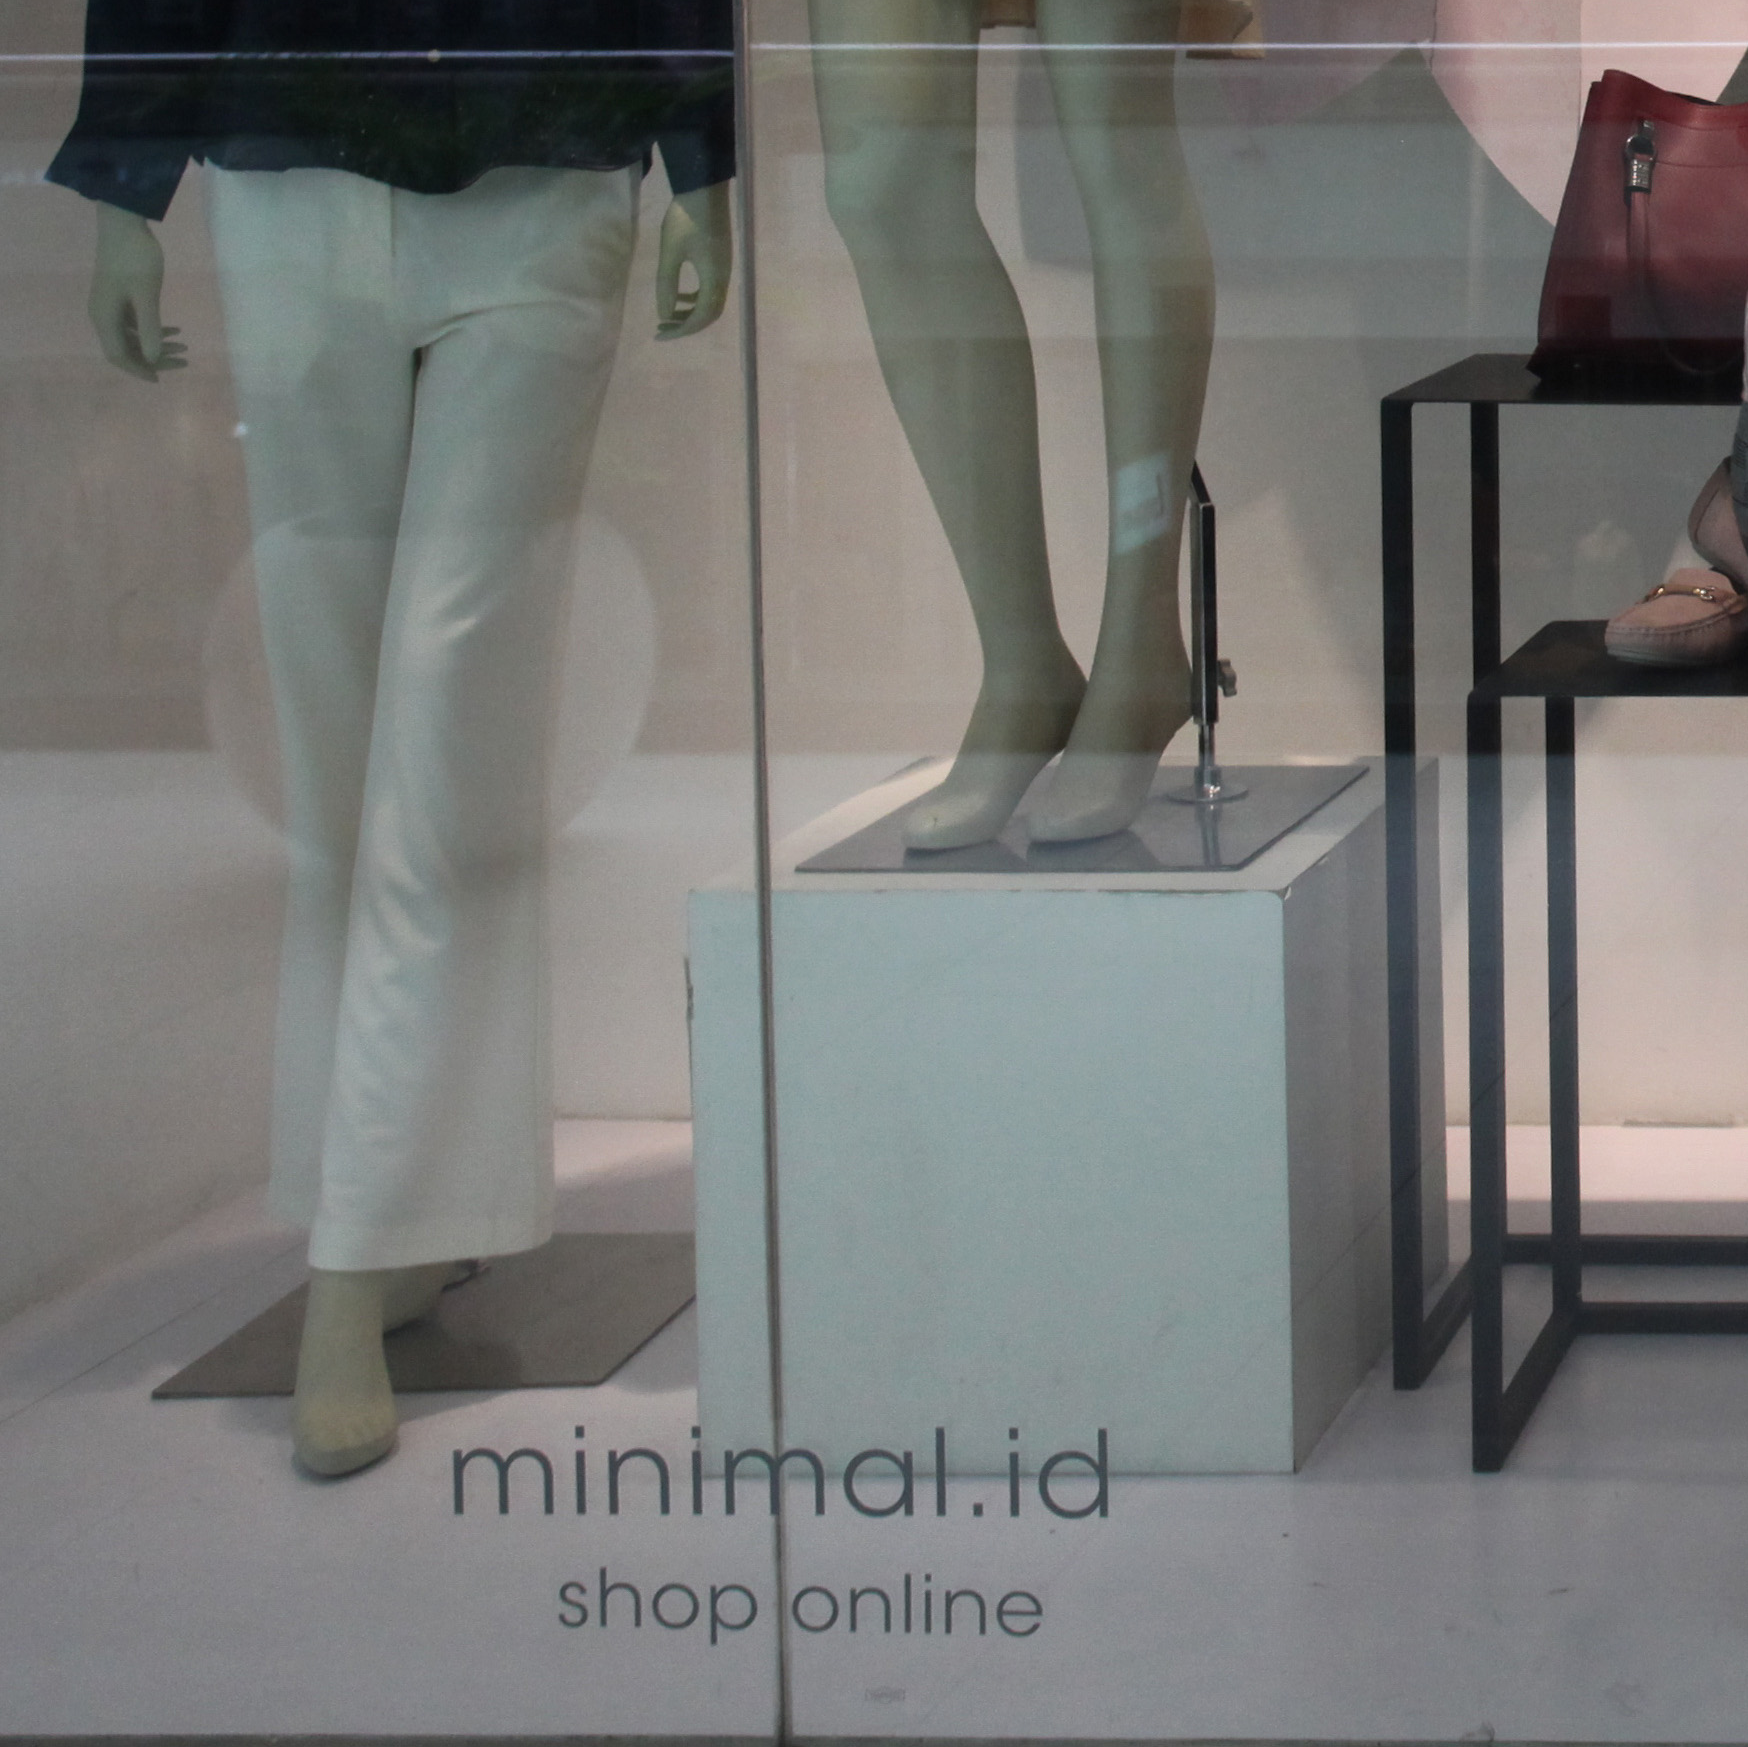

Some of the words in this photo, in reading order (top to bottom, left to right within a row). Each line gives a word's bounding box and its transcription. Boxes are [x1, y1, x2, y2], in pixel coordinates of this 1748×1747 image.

[452, 1425, 1110, 1520] minimal.id
[558, 1567, 759, 1645] shop
[791, 1573, 1044, 1637] online
